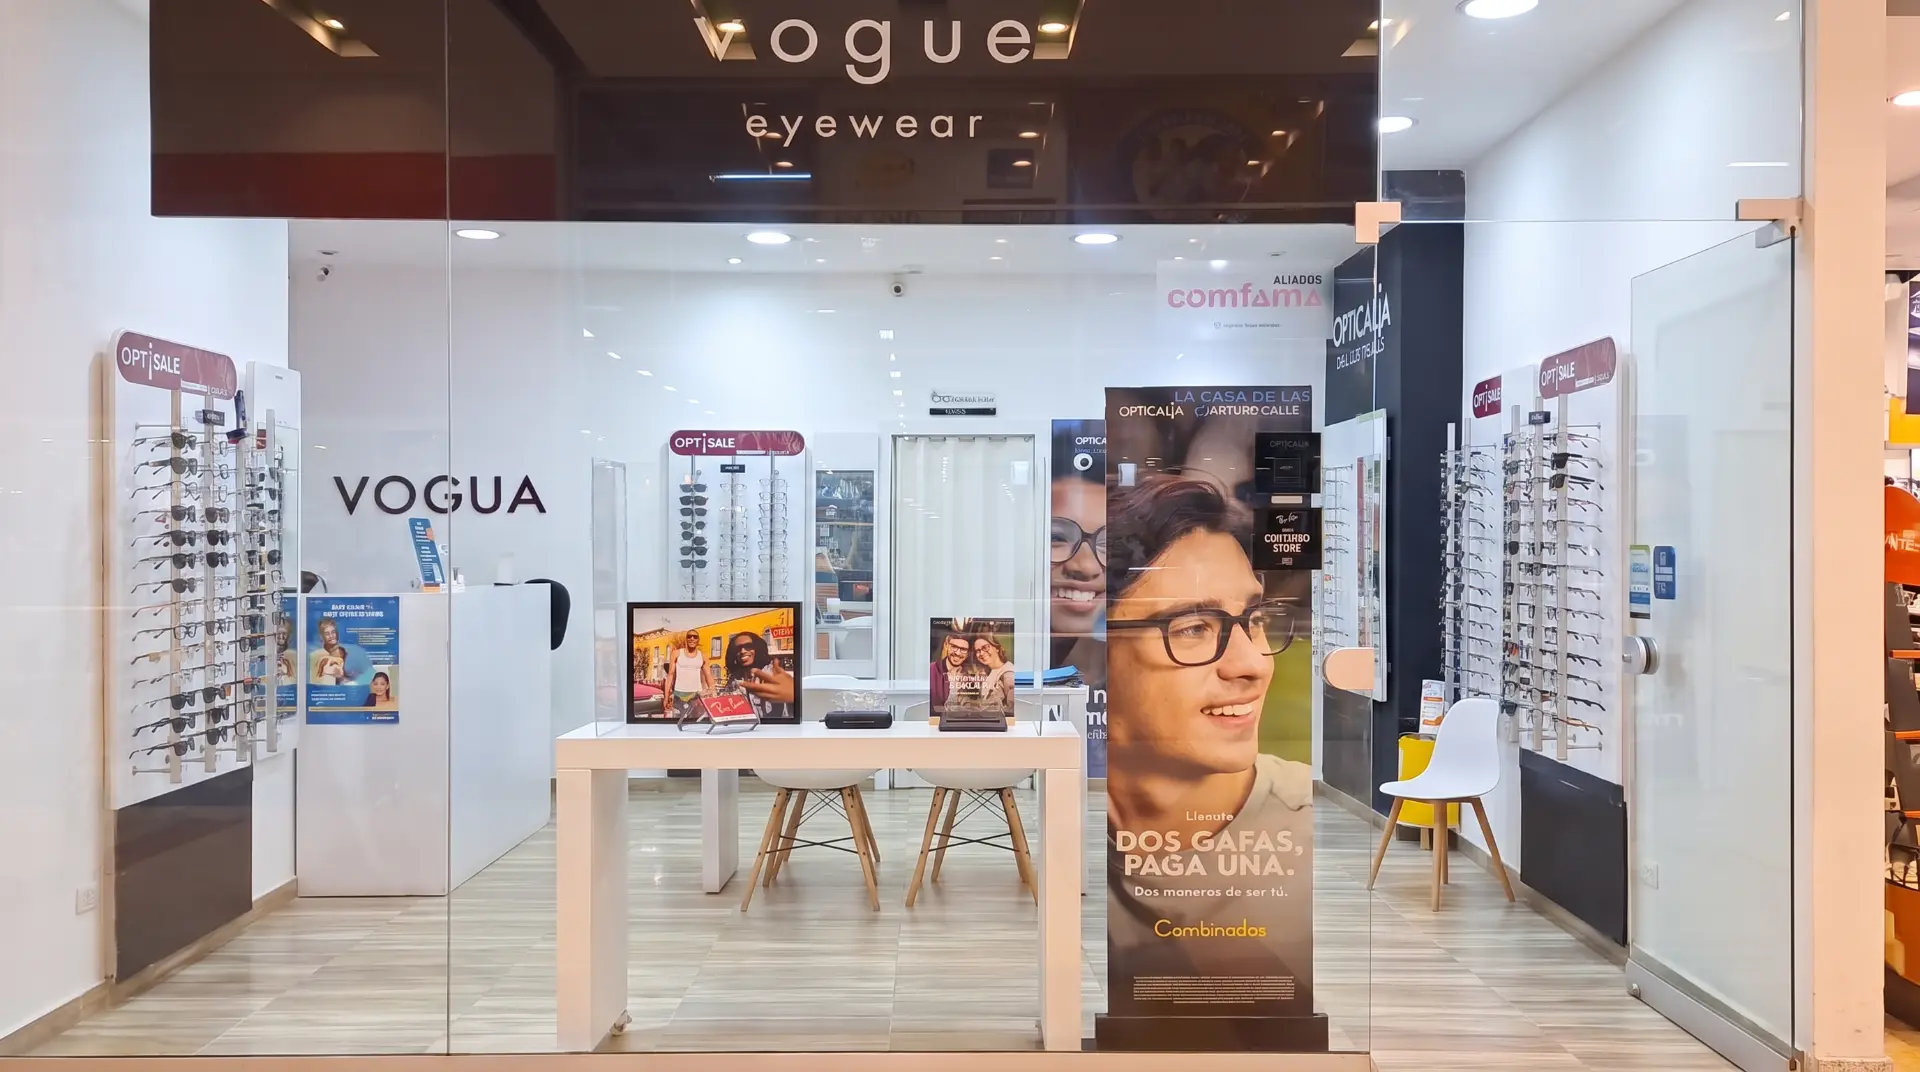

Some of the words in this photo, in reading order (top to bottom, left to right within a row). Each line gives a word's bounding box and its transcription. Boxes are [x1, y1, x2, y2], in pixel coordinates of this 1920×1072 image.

[694, 17, 1032, 85] vogue
[746, 114, 985, 147] eyewear
[1273, 275, 1322, 285] ALIADOS
[1167, 283, 1323, 308] comfama
[1174, 391, 1195, 402] LA
[1200, 391, 1247, 402] CASA
[1252, 391, 1275, 402] DE
[1281, 391, 1310, 402] LAS
[1260, 405, 1300, 416] CALLE
[333, 475, 547, 516] VOGUA
[1272, 543, 1302, 553] STORE
[1115, 830, 1182, 853] DOS
[1191, 830, 1304, 857] GAFAS,
[1124, 853, 1208, 877] PAGA
[1217, 853, 1295, 877] UNA.
[1134, 885, 1160, 898] Dos
[1225, 885, 1242, 898] de
[1246, 887, 1267, 898] ser
[1154, 918, 1268, 938] Combinados
